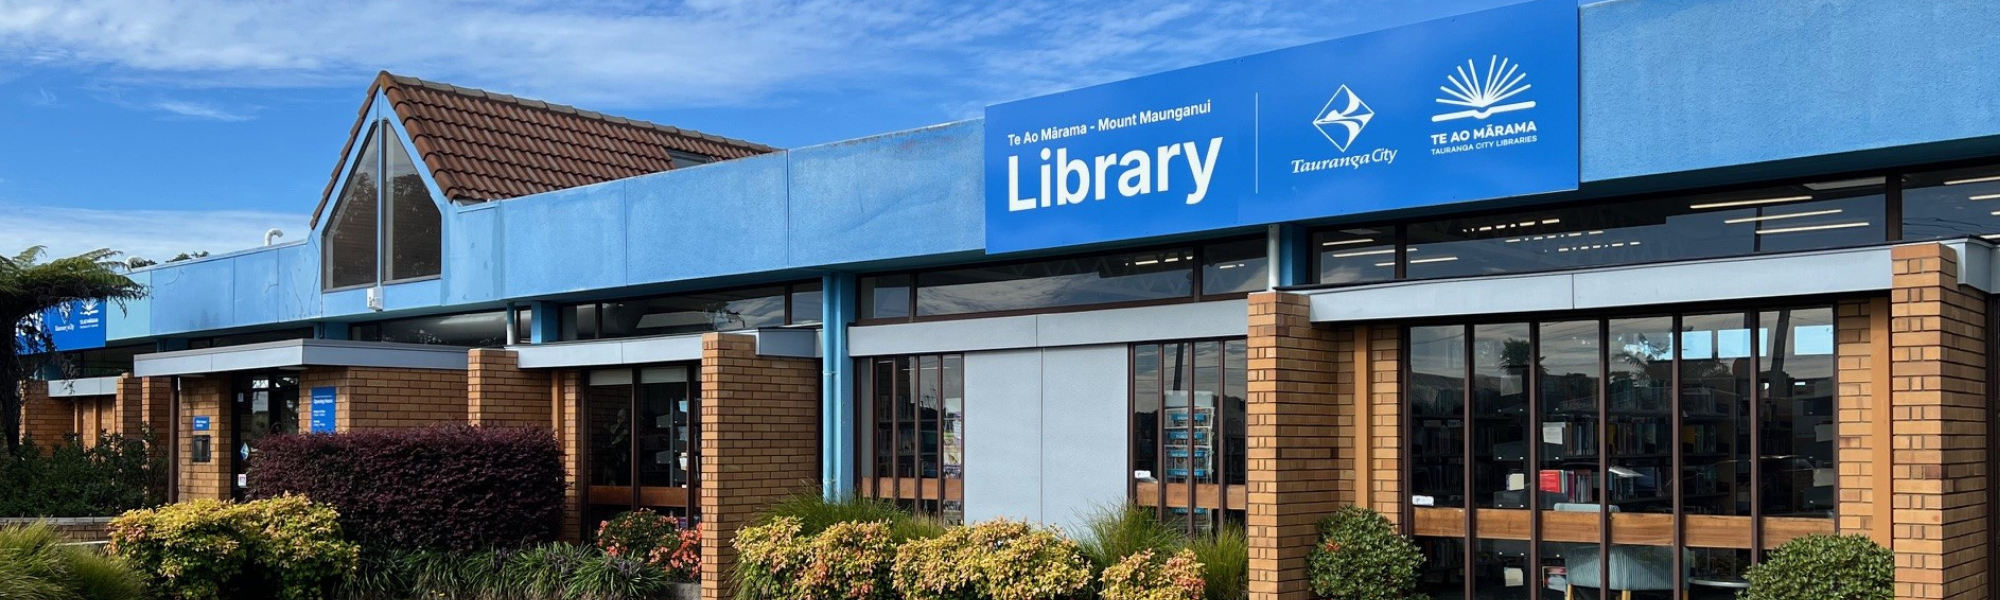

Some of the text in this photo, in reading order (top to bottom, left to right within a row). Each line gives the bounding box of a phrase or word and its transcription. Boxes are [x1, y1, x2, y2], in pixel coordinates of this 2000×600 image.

[1008, 133, 1022, 147] Te
[1023, 131, 1039, 144] Ao
[1040, 124, 1088, 141] Mārama
[1097, 113, 1138, 132] Mount
[1139, 99, 1212, 124] Maunganui
[1430, 121, 1538, 145] TE AO MĀRAMA
[1431, 135, 1538, 156] TAURANGA CITY LIBRARIES
[1007, 135, 1224, 212] Library
[1291, 148, 1398, 174] Tauranga City
